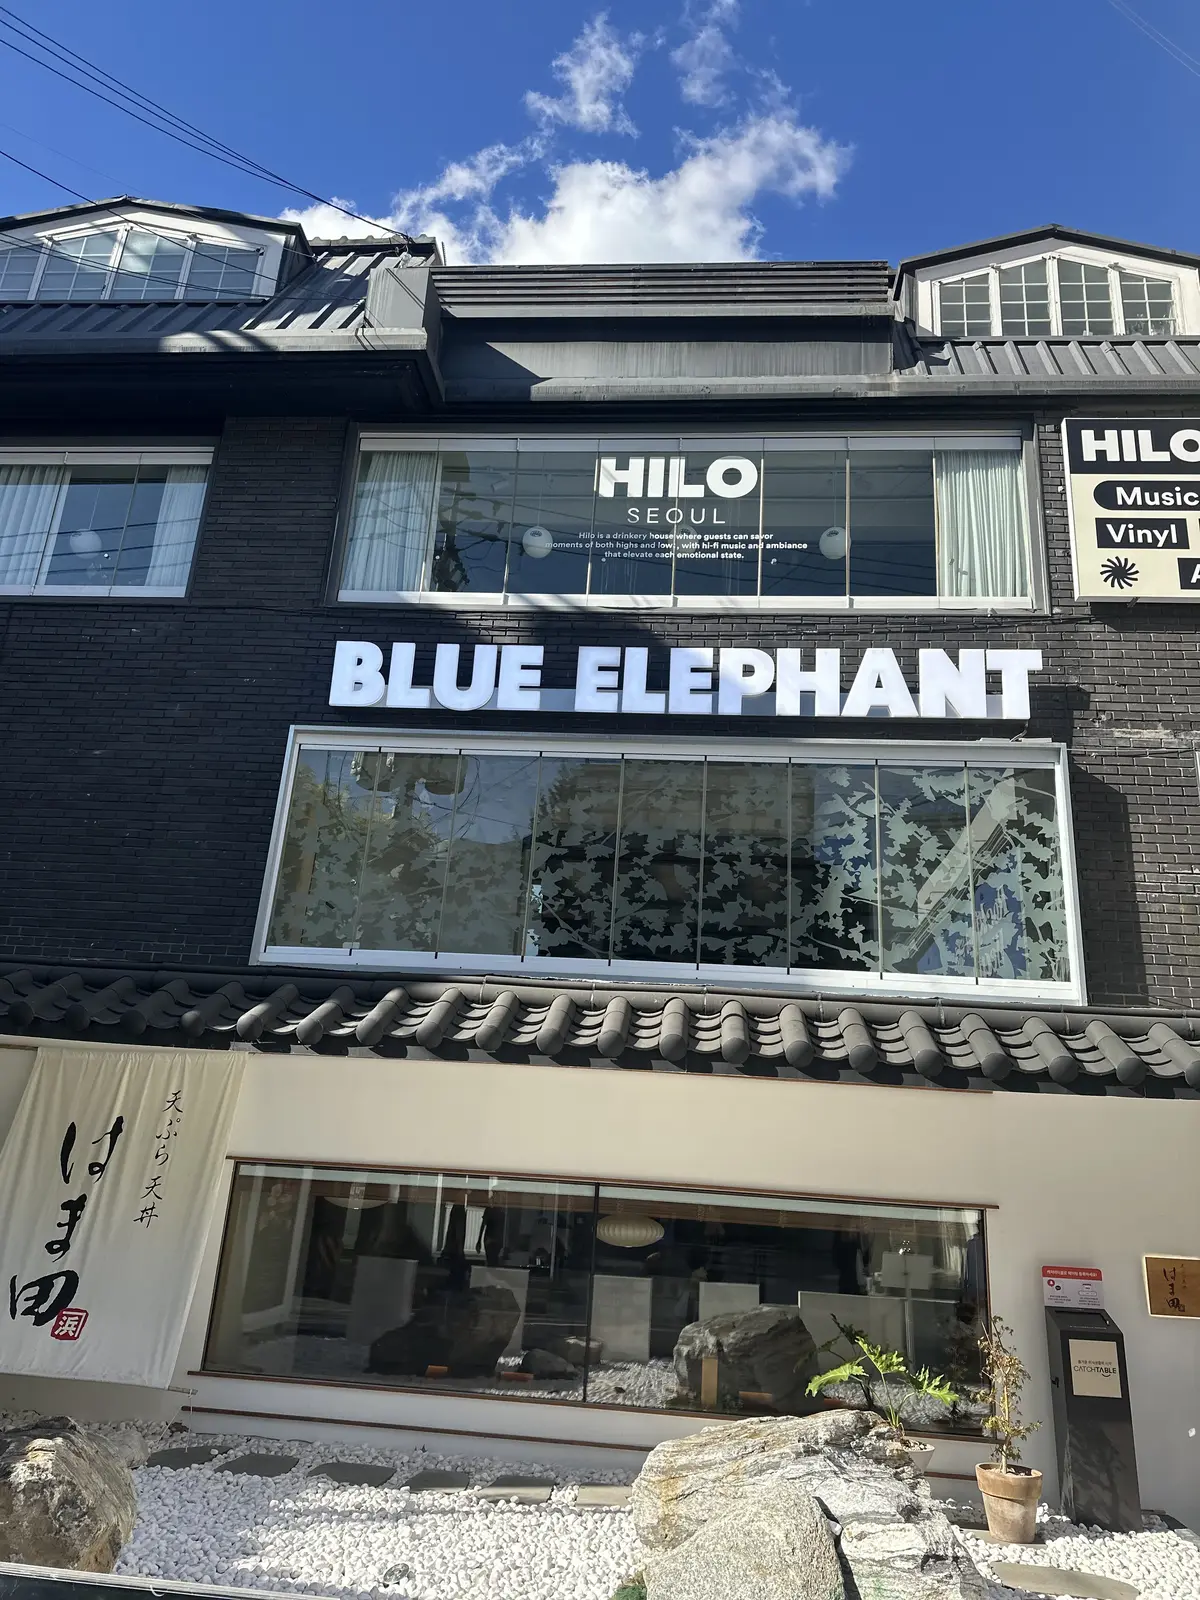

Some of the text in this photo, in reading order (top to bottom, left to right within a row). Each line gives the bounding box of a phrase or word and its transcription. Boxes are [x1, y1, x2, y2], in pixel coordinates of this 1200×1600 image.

[1081, 429, 1200, 463] HILO
[599, 456, 758, 499] HILO
[1116, 486, 1200, 506] Music
[627, 507, 726, 525] SEOUL
[612, 532, 647, 540] drinkery
[649, 532, 674, 540] house
[676, 532, 702, 540] where
[703, 533, 731, 541] guests
[616, 541, 638, 550] highs
[681, 542, 700, 550] with
[702, 542, 719, 550] hi-fi
[720, 542, 746, 550] music
[747, 542, 764, 550] and
[765, 542, 808, 550] ambiance
[1106, 523, 1178, 548] Vinyl
[623, 551, 653, 559] elevate
[654, 551, 675, 559] each
[676, 551, 719, 559] emotional
[329, 640, 1044, 721] BLUE ELEPHANT
[9, 1115, 124, 1326] はま田
